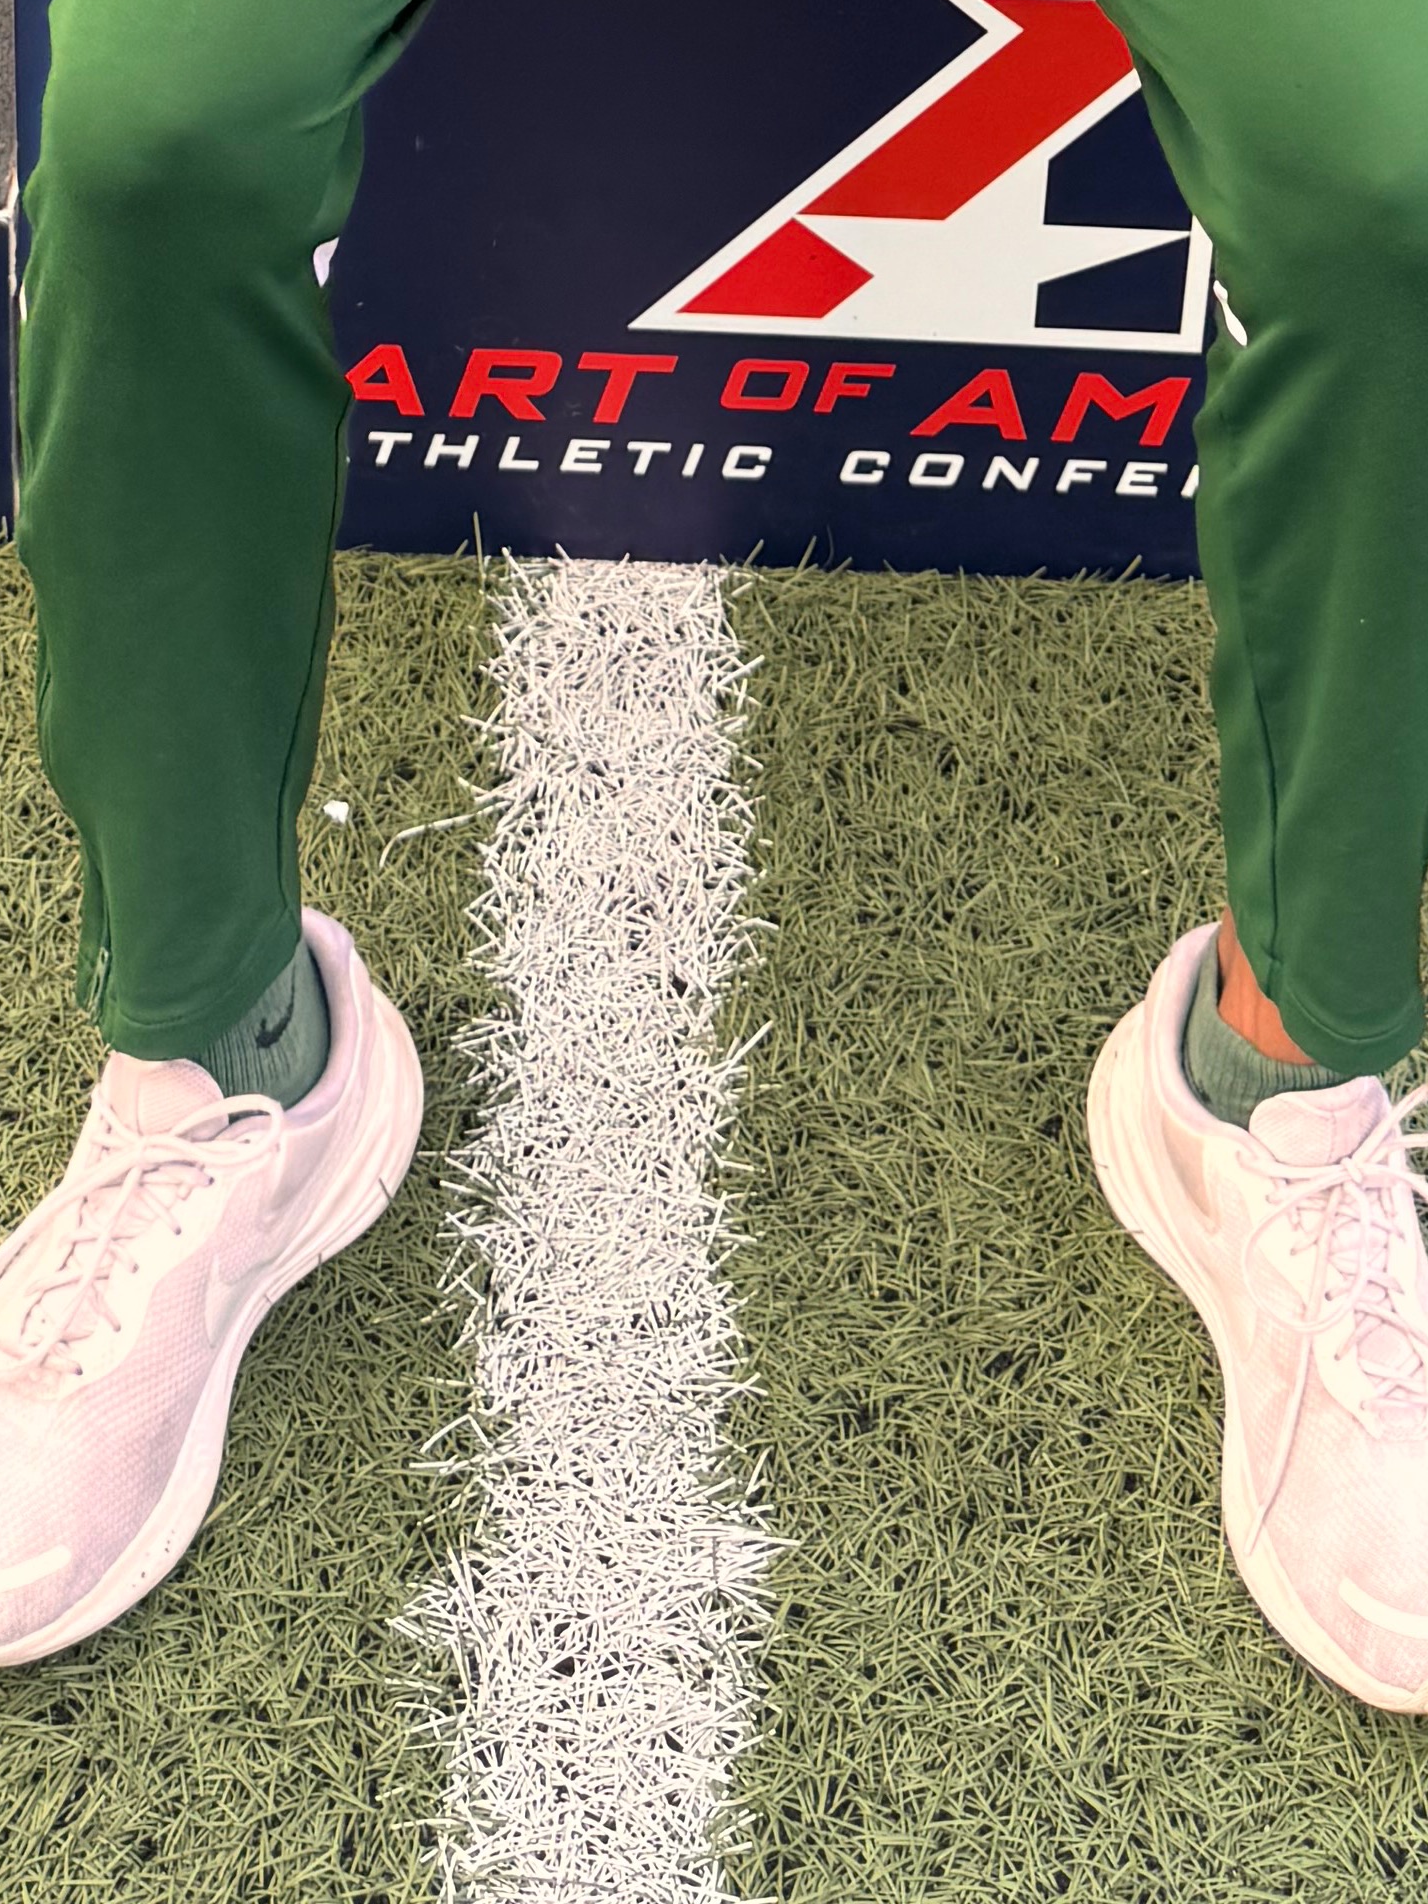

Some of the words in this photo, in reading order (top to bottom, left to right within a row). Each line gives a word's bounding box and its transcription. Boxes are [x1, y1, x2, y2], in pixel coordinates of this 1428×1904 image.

[345, 343, 680, 424] ART
[719, 357, 897, 415] OF
[365, 431, 773, 480] THLETIC
[839, 448, 1200, 499] CONFE
